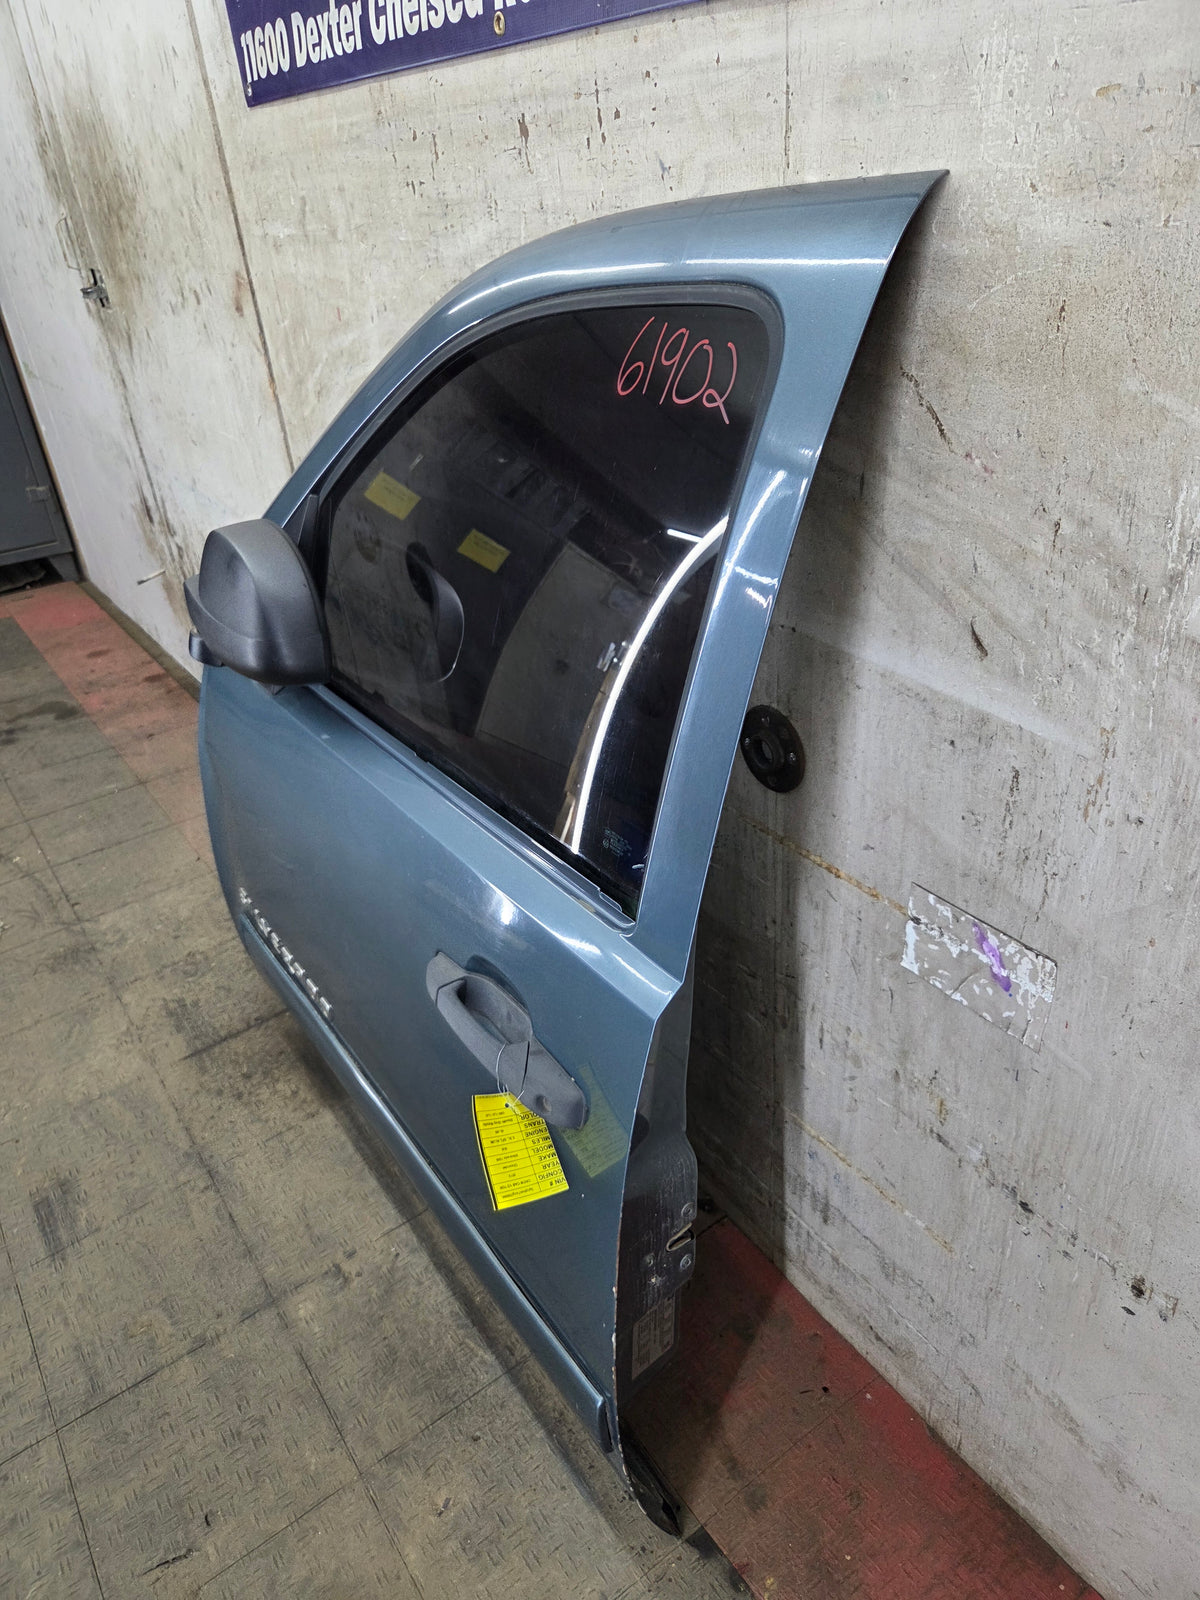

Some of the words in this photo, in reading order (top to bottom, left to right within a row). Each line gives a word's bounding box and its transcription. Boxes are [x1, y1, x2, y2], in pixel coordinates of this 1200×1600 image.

[240, 17, 290, 83] 11600
[291, 0, 362, 68] Dexter
[616, 316, 738, 425] 61902
[520, 1112, 538, 1121] OLOR
[524, 1119, 545, 1129] TRANS
[525, 1127, 548, 1137] ENGINE
[531, 1136, 551, 1145] MILES
[531, 1144, 553, 1154] MODEL
[539, 1152, 556, 1161] MAKE
[542, 1160, 560, 1170] YEAR
[538, 1169, 562, 1180] CONFIG
